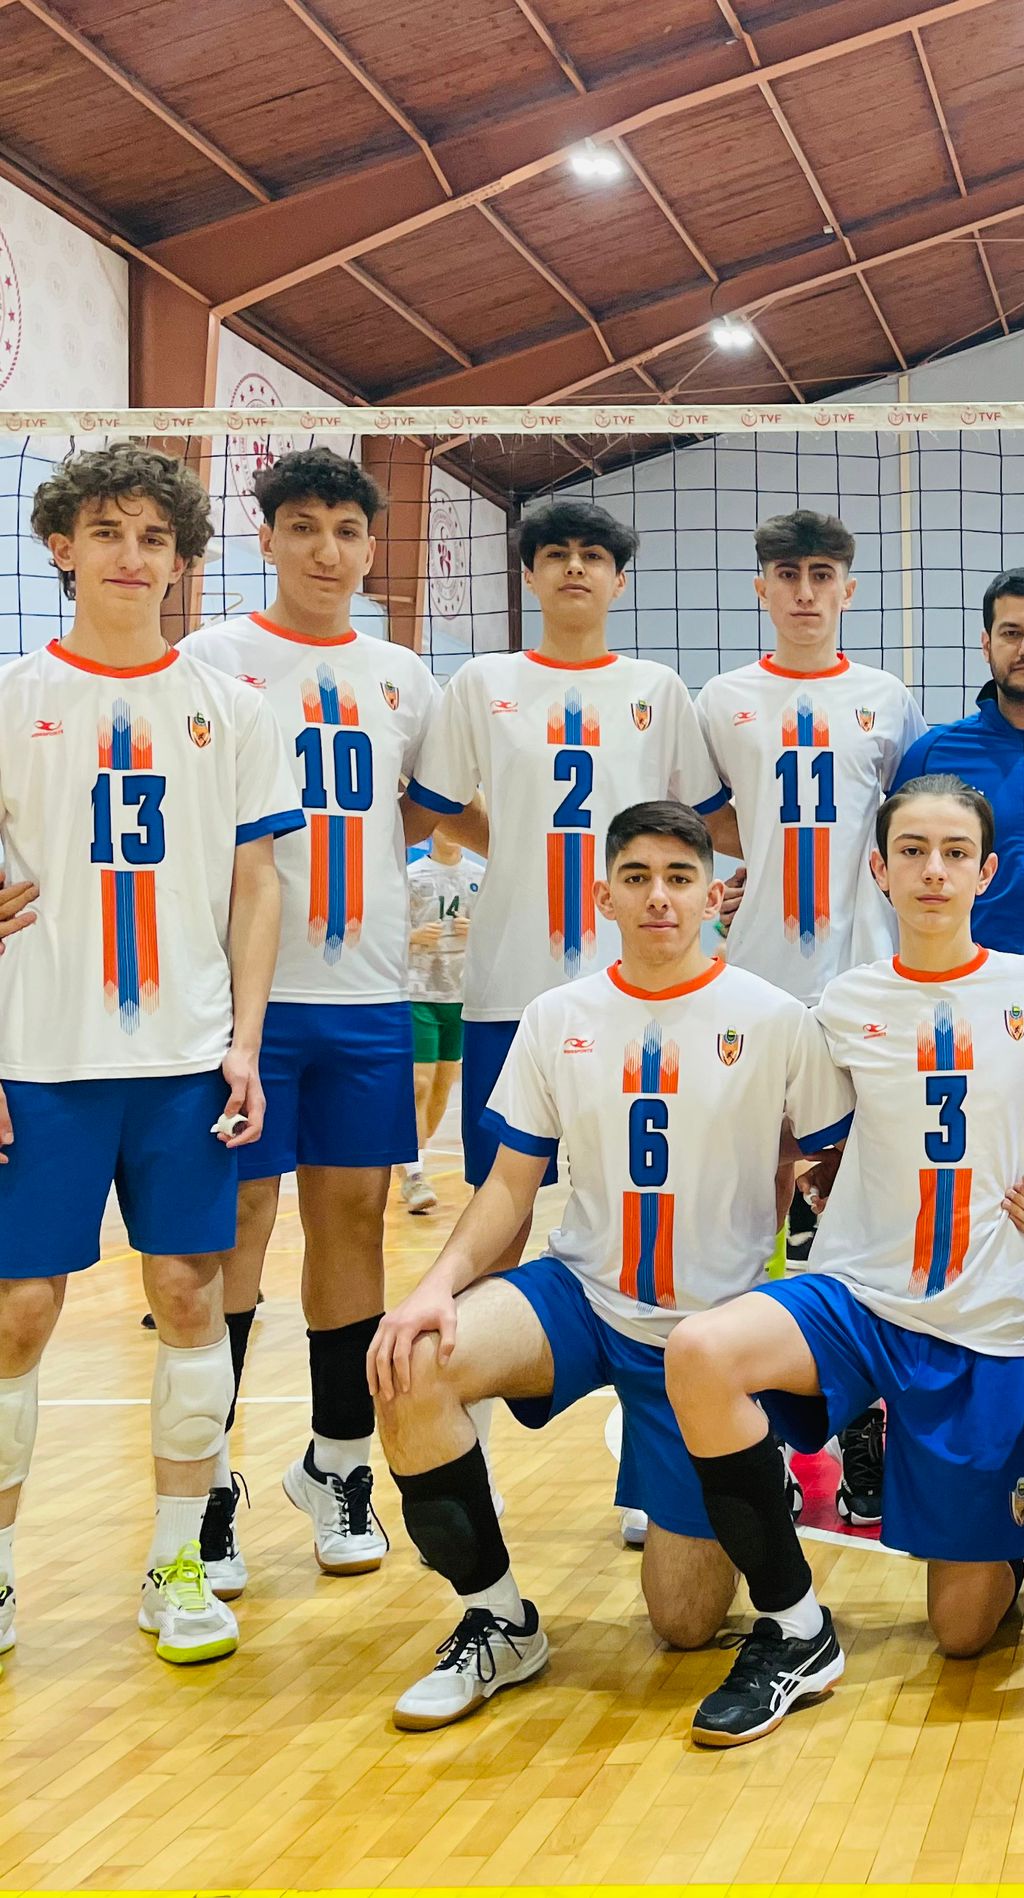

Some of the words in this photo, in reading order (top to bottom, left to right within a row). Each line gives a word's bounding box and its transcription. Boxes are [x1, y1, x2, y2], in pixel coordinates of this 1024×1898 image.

[25, 418, 46, 427] TVF
[98, 418, 119, 427] TVF
[172, 418, 194, 426] TVF
[243, 418, 267, 426] TVF
[319, 417, 340, 426] TVF
[394, 417, 415, 425] TVF
[466, 417, 488, 425] TVF
[540, 416, 561, 425] TVF
[613, 416, 634, 424] TVF
[686, 415, 707, 424] TVF
[760, 415, 781, 423] TVF
[833, 414, 854, 422] TVF
[906, 413, 928, 422] TVF
[979, 412, 1001, 421] TVF
[296, 727, 373, 811] 10
[553, 750, 593, 827] 2
[775, 750, 836, 823] 11
[90, 774, 165, 864] 13
[439, 895, 460, 920] 14
[629, 1099, 668, 1187] 6
[925, 1076, 968, 1163] 3
